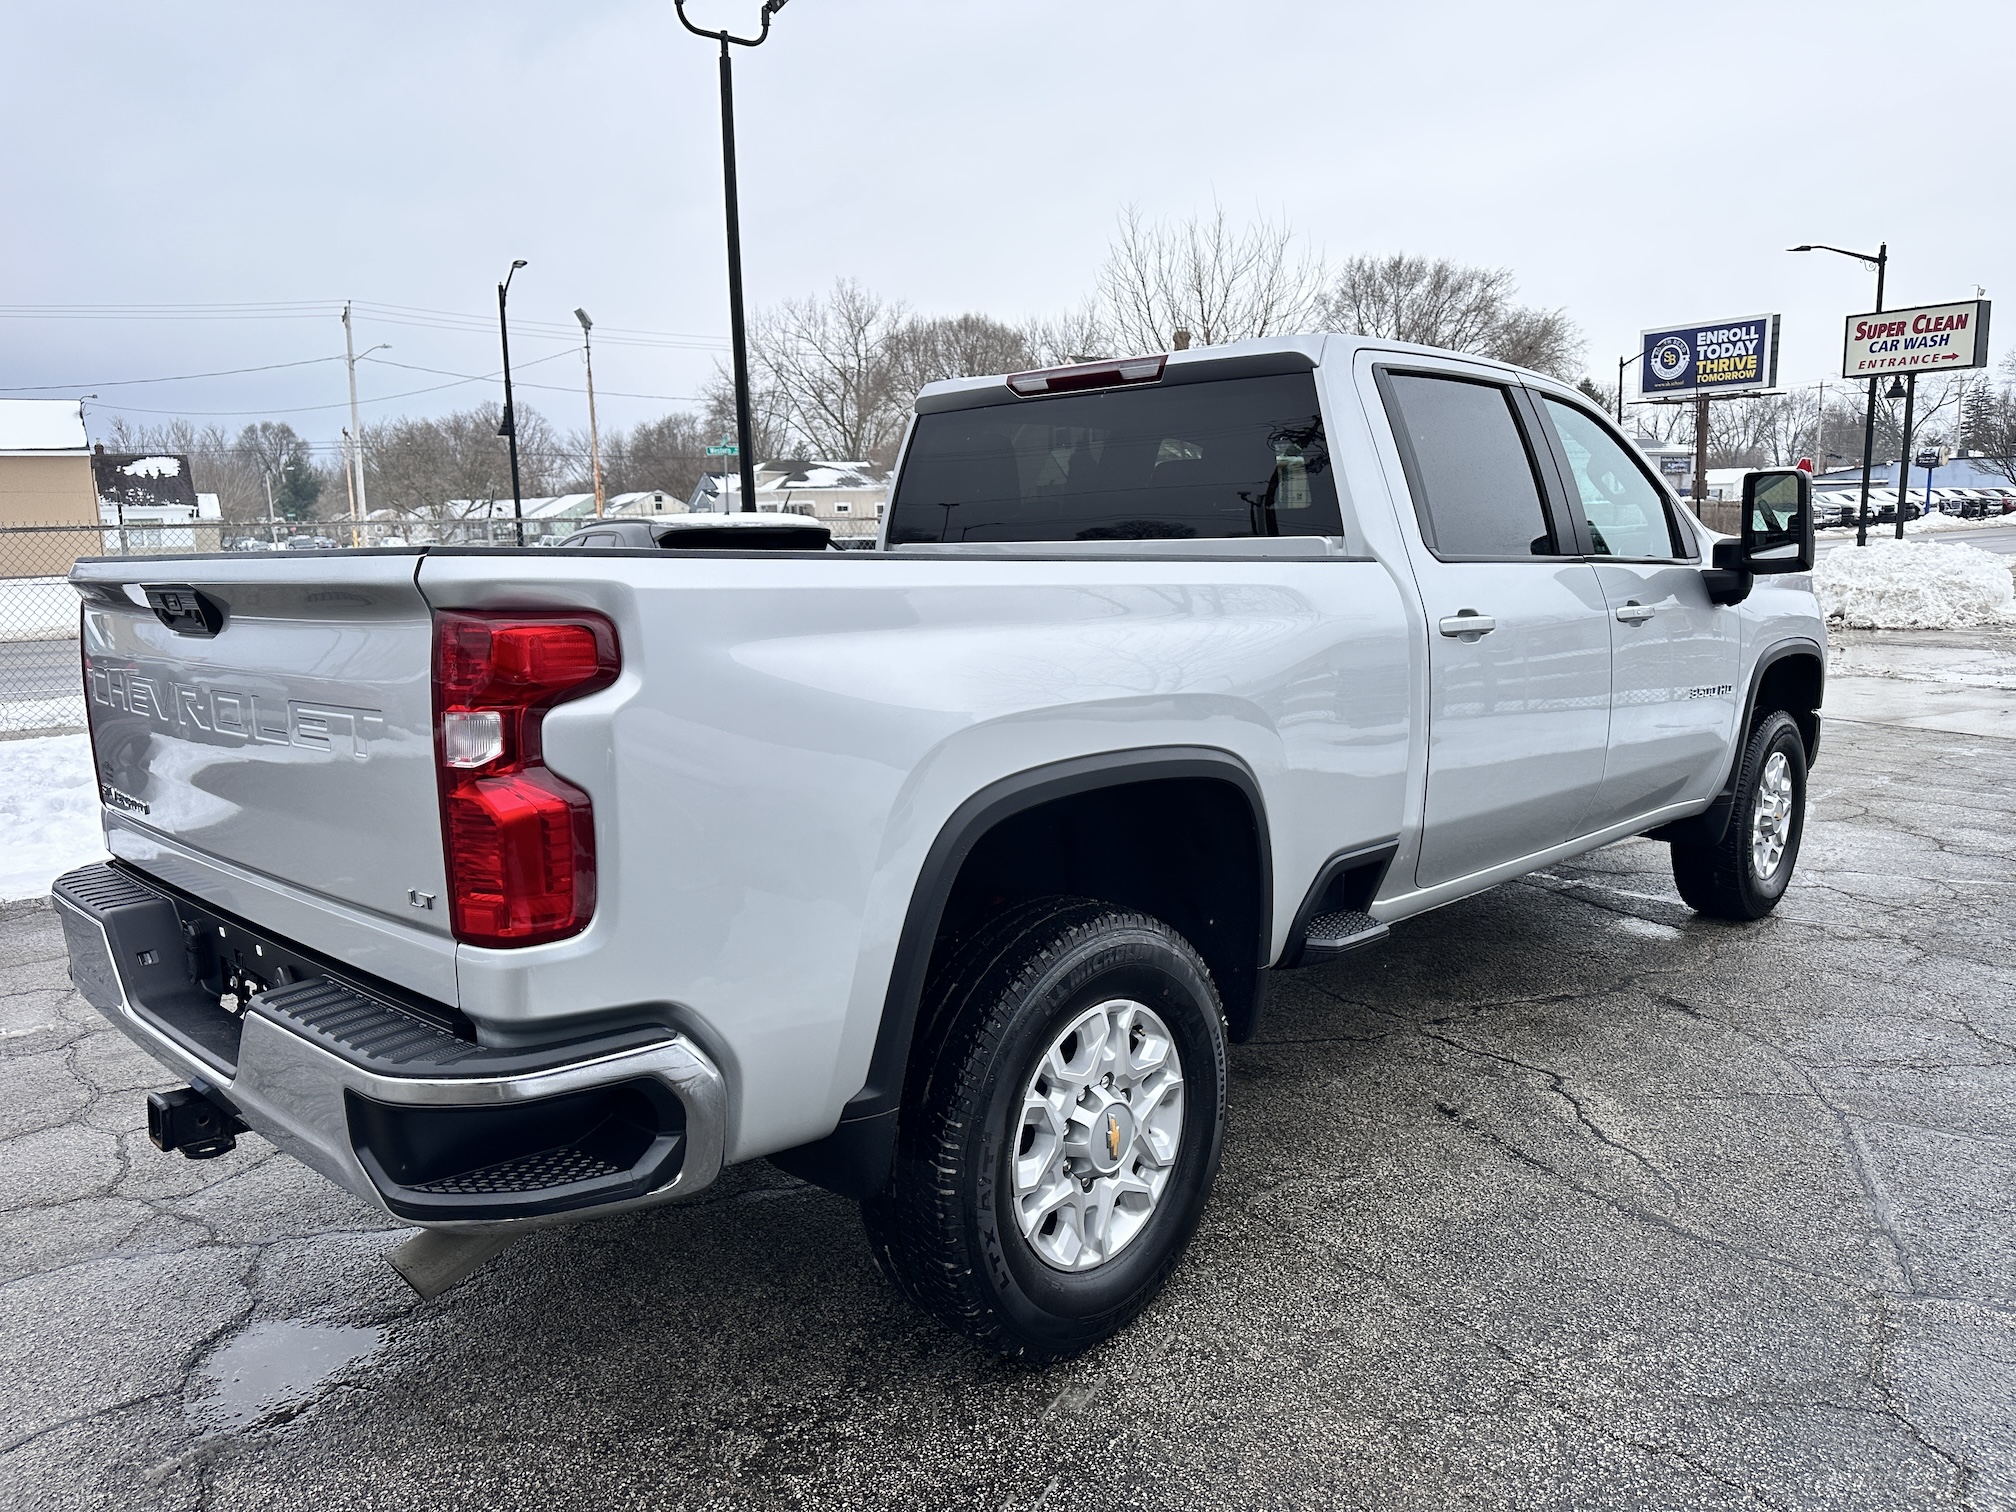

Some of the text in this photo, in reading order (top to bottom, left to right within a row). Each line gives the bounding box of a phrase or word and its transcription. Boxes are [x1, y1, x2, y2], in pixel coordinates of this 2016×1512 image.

[1696, 326, 1759, 346] ENROLL
[1855, 313, 1969, 341] SUPER CLEAN
[1696, 340, 1759, 360] TODAY
[1869, 333, 1951, 354] CAR WASH
[1663, 351, 1677, 366] SB
[1696, 355, 1757, 375] THRIVE
[1858, 353, 1941, 370] ENTRANCE
[1696, 369, 1756, 384] TOMORROW
[91, 668, 383, 758] CHEVROLET
[407, 889, 436, 910] LT
[983, 1226, 1011, 1290] LTX
